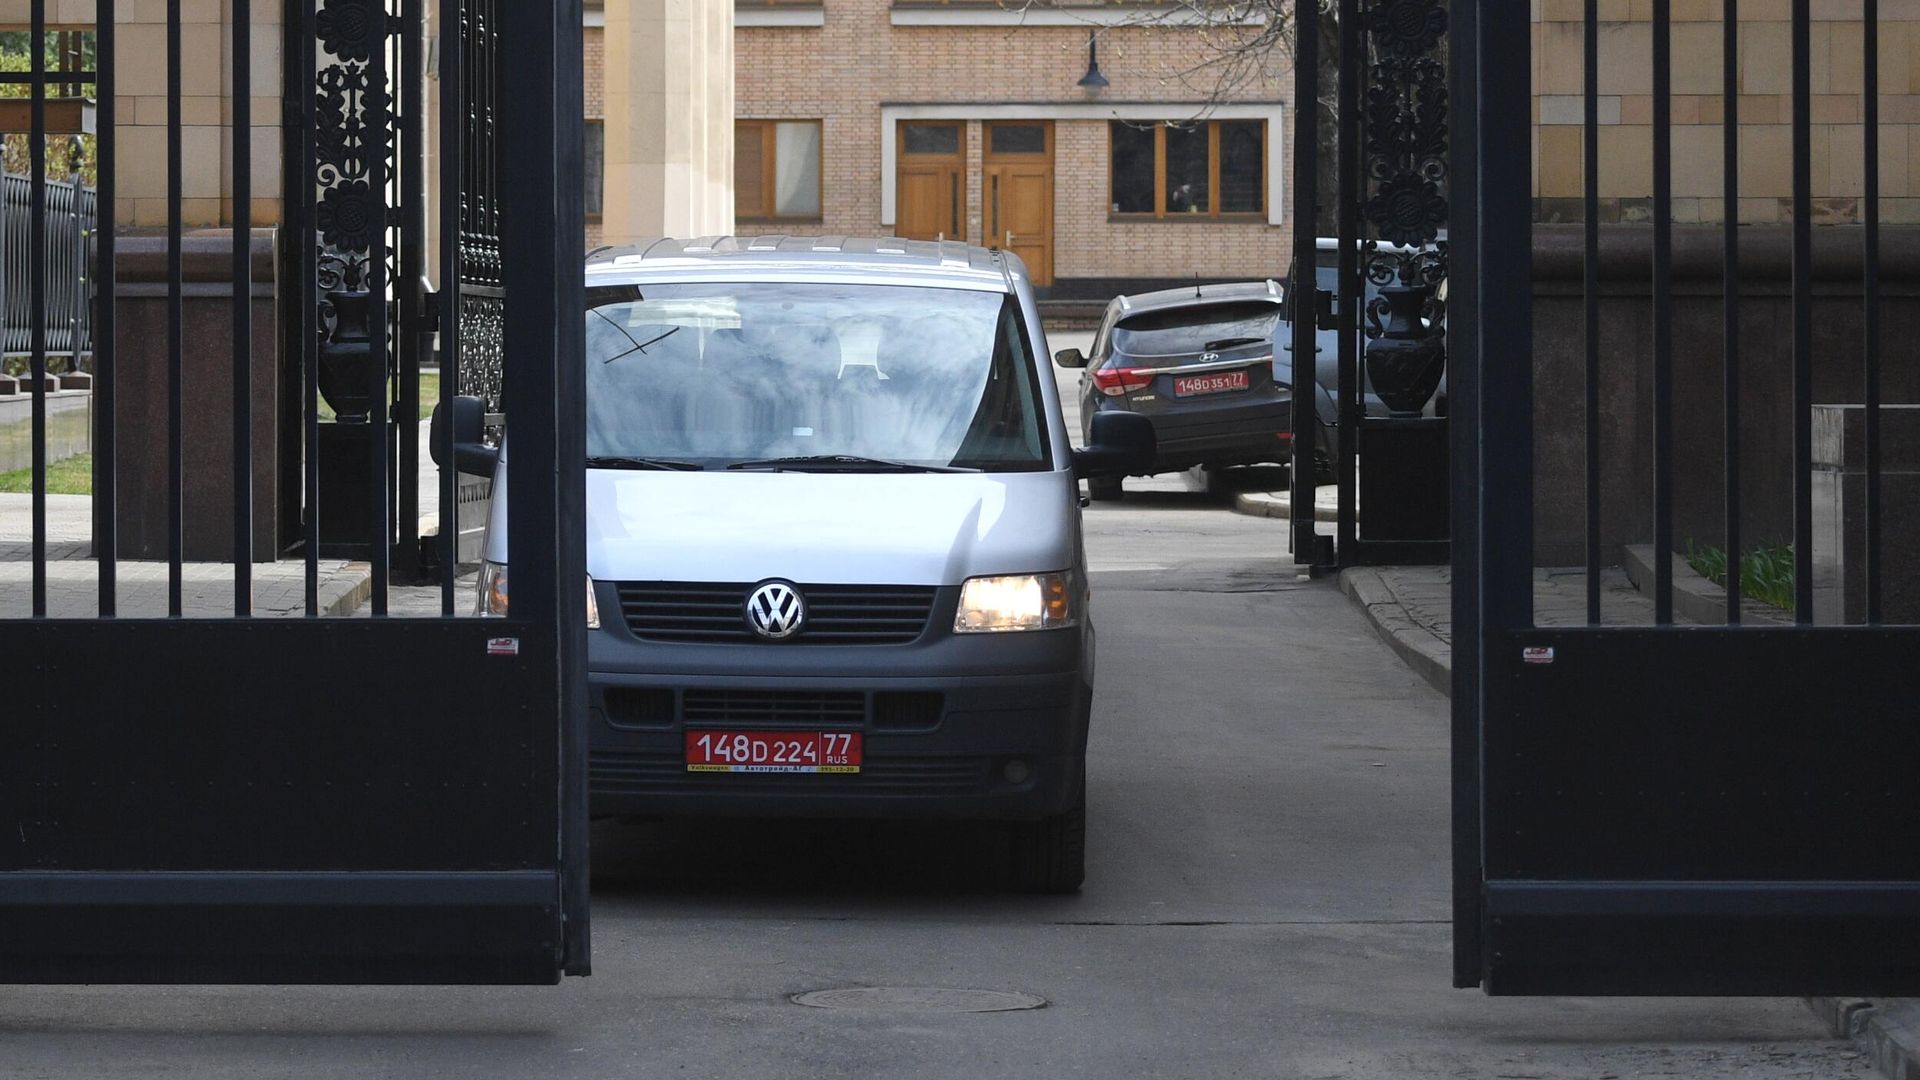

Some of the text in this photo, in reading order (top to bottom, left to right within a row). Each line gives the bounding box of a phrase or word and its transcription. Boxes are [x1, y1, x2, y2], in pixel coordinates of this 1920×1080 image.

[1231, 372, 1244, 384] 77
[823, 733, 852, 755] 77
[826, 755, 848, 764] RUS
